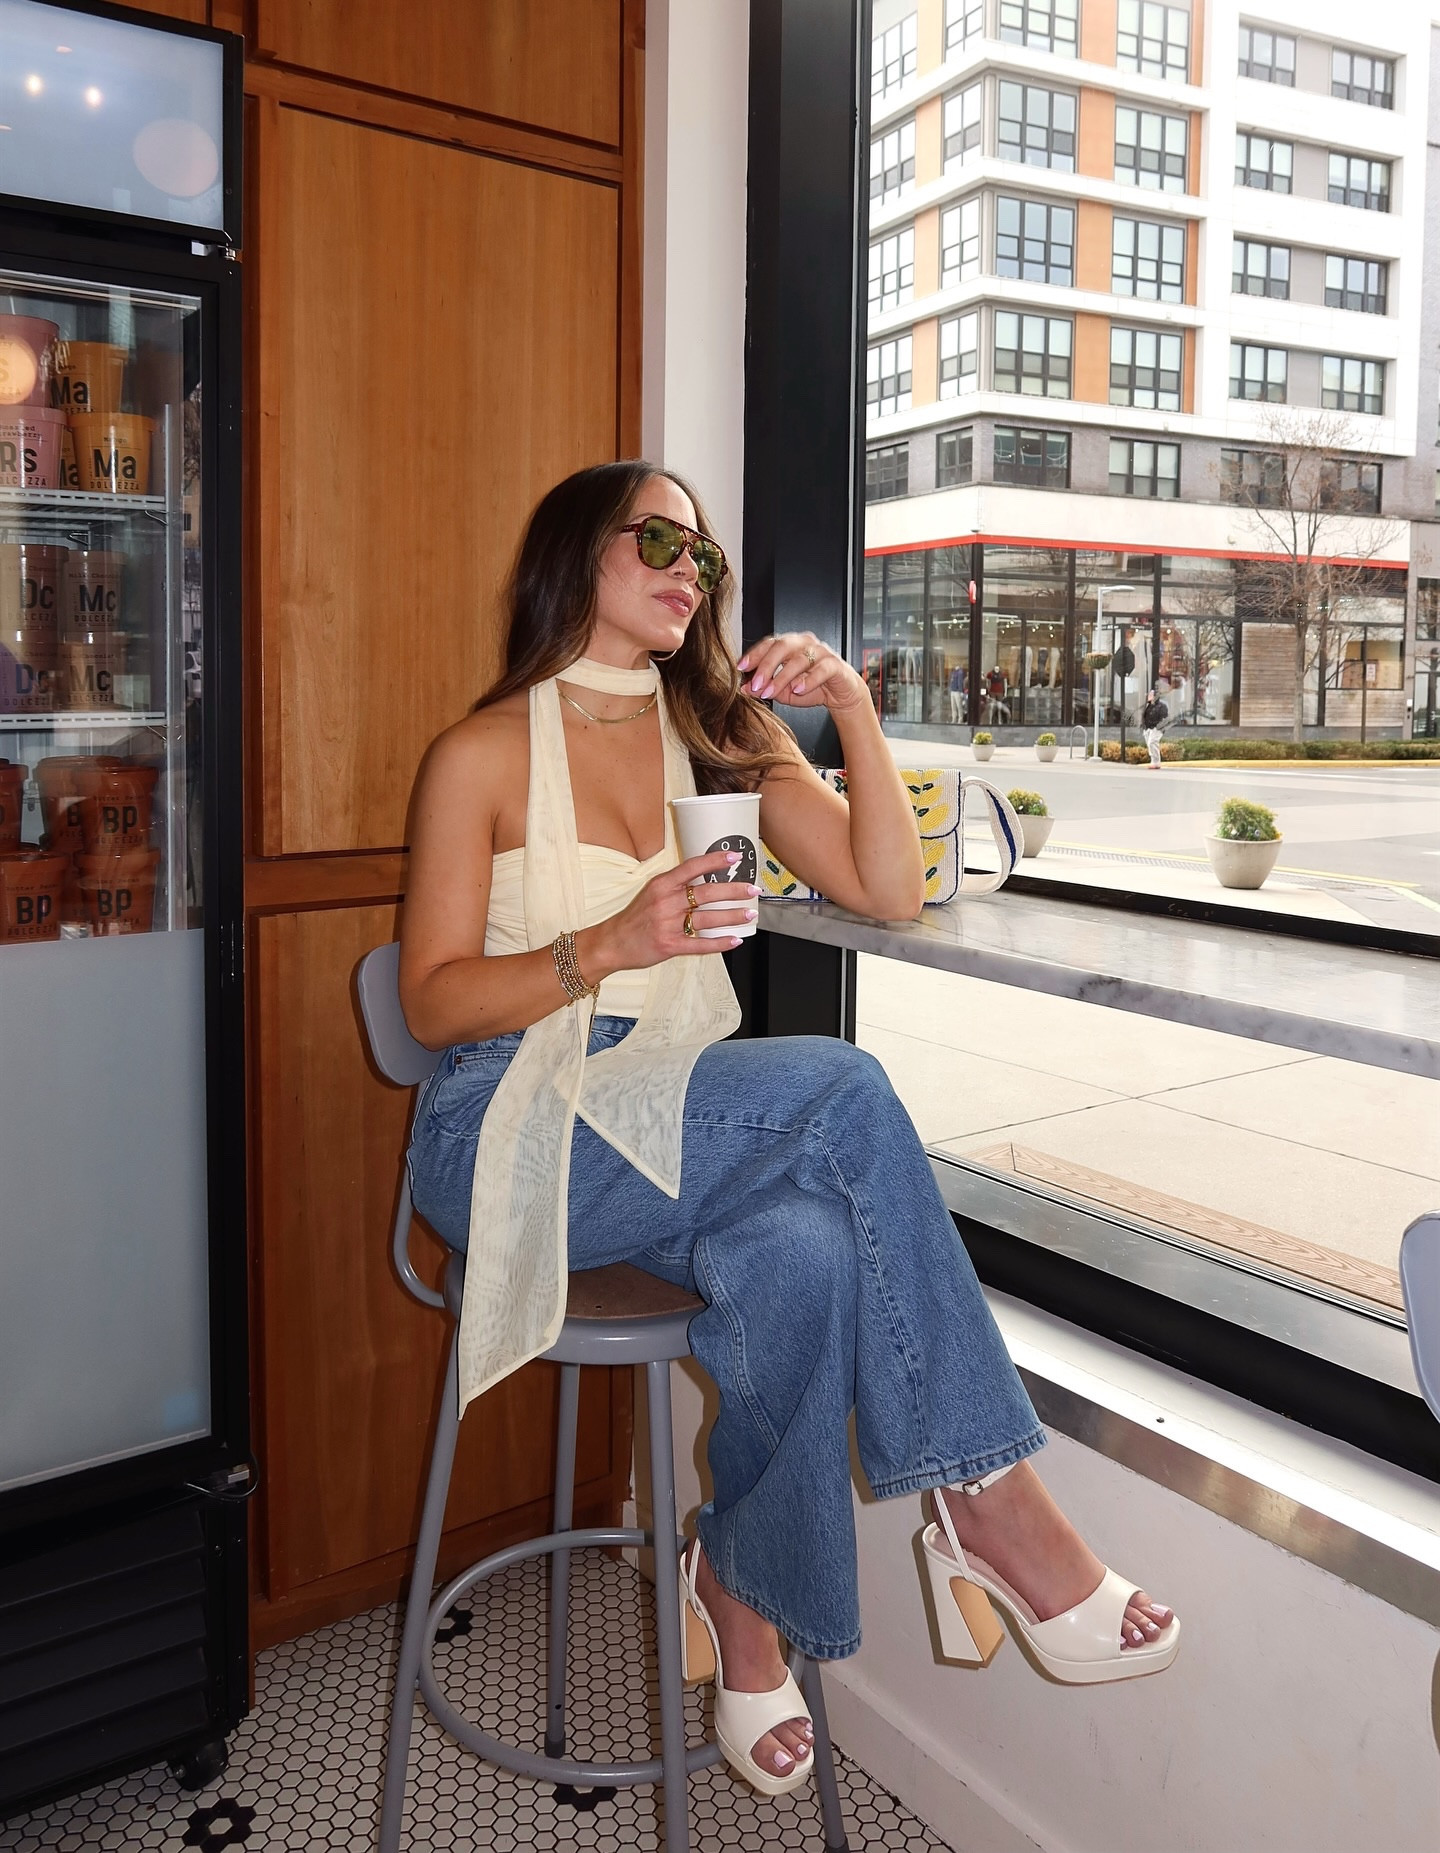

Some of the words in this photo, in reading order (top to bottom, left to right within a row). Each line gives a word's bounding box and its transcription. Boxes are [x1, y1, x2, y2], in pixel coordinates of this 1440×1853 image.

[93, 448, 137, 479] Ma
[20, 578, 54, 609] Dc
[79, 584, 116, 612] Mc
[15, 663, 49, 694] Dc
[70, 665, 111, 692] Mc
